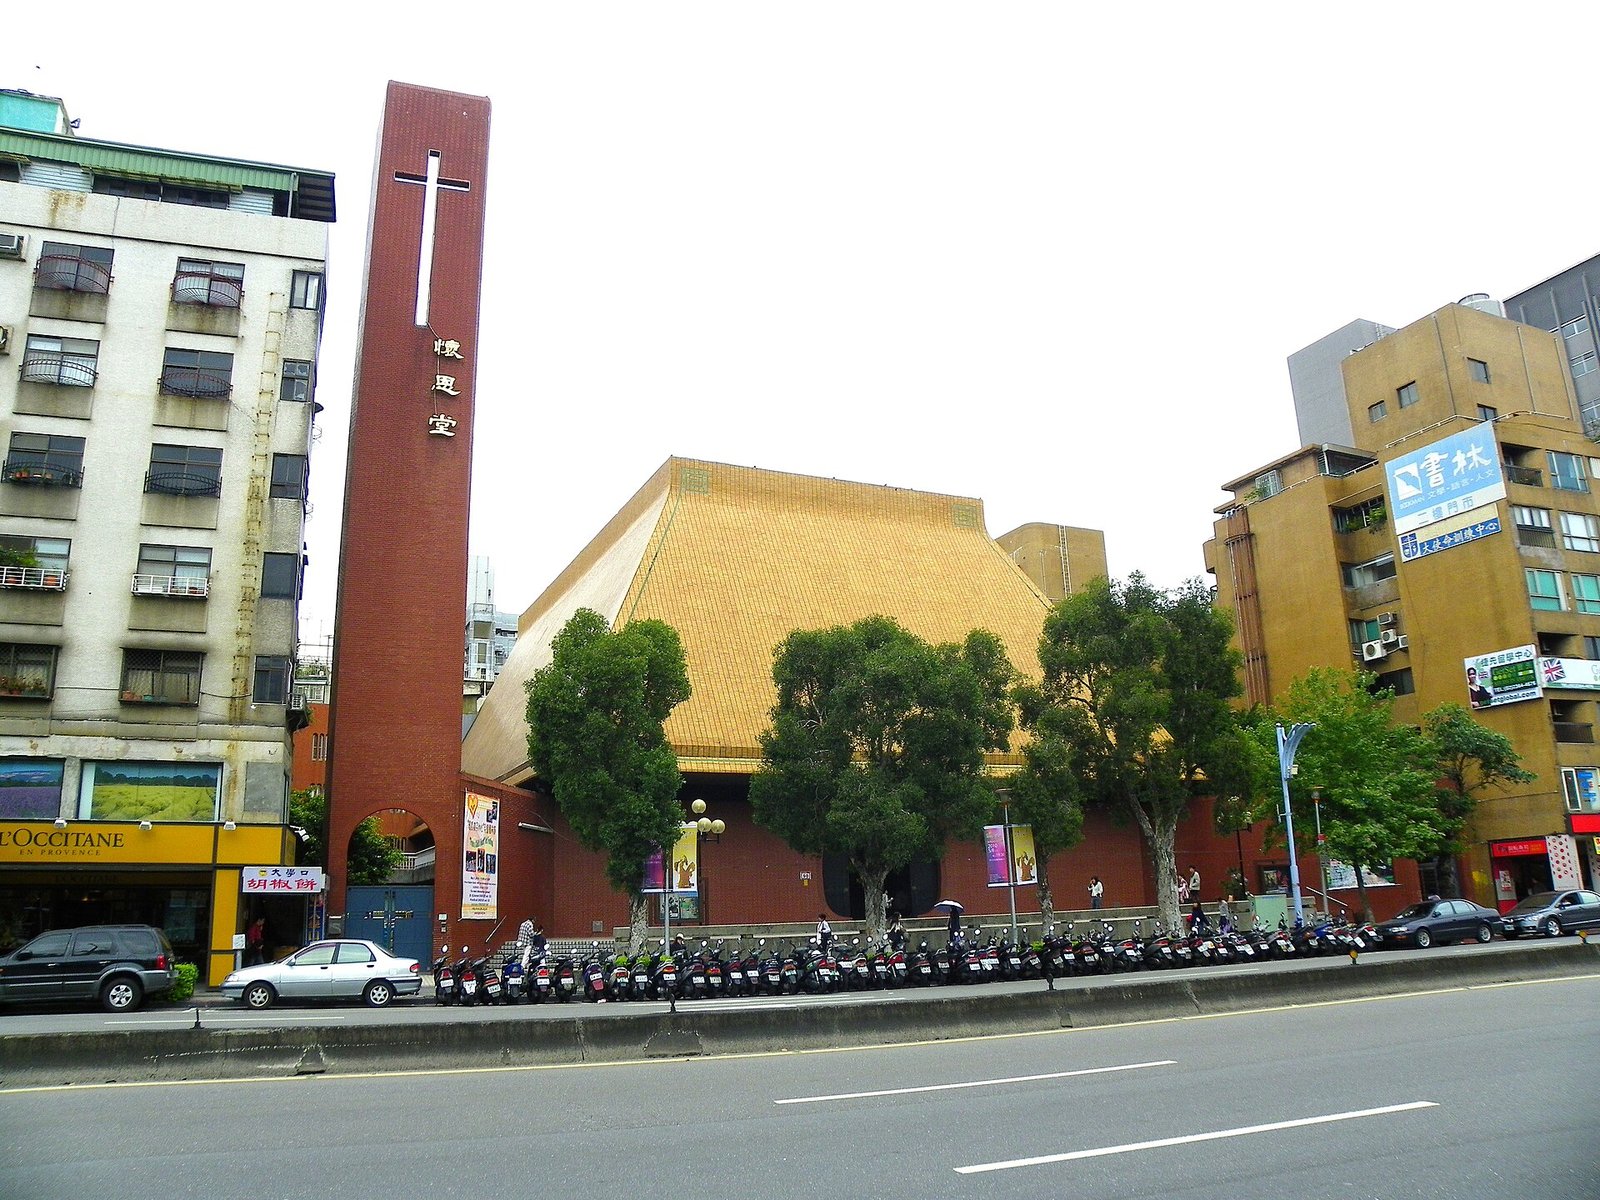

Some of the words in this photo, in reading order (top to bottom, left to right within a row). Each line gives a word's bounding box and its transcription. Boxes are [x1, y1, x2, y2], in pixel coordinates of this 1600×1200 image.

[428, 338, 464, 437] 懷恩堂
[1420, 443, 1492, 488] 書林
[0, 828, 124, 848] L'OCCITANE
[271, 868, 309, 878] 大學口
[247, 878, 318, 891] 胡椒餅
